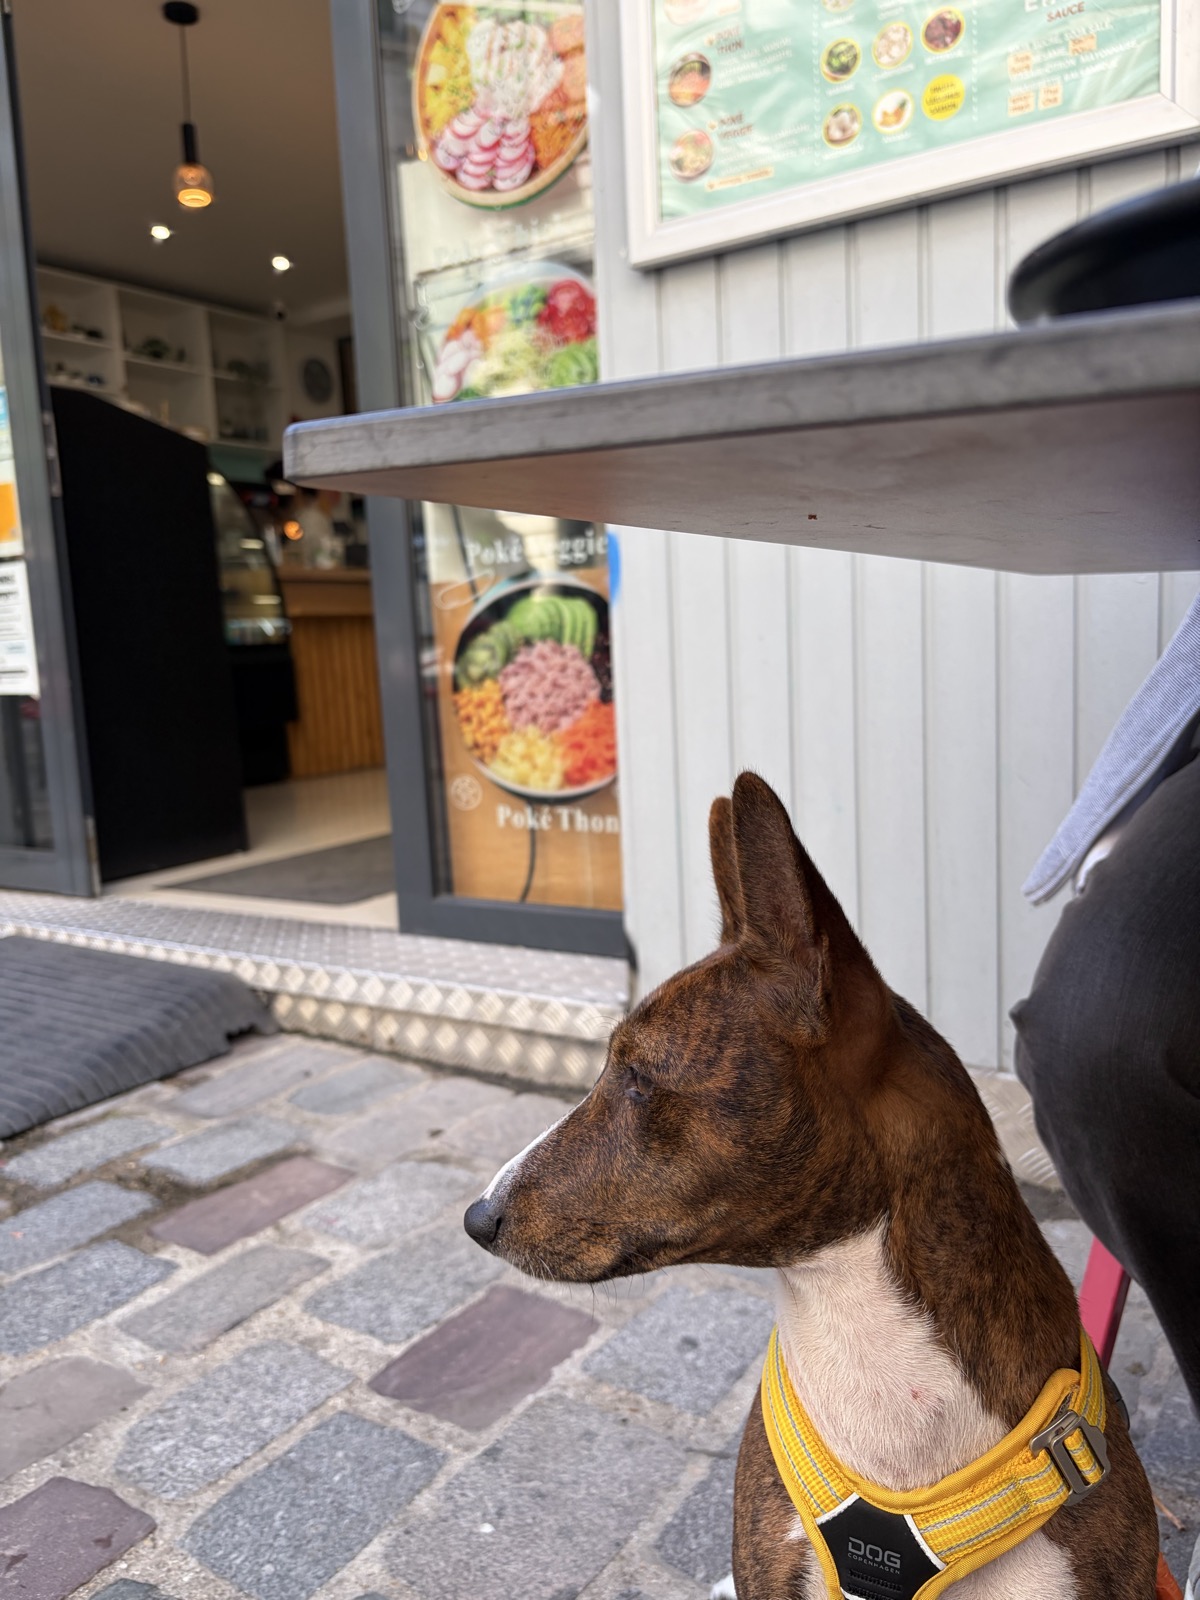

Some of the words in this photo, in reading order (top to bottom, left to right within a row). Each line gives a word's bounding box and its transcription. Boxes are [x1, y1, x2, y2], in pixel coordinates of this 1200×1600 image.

[1046, 1, 1086, 22] SAUCE
[466, 536, 523, 566] Poké
[496, 803, 553, 829] Poké
[556, 805, 620, 833] Thon
[848, 1554, 900, 1574] COPENHAGEN
[849, 1537, 901, 1568] DOG
